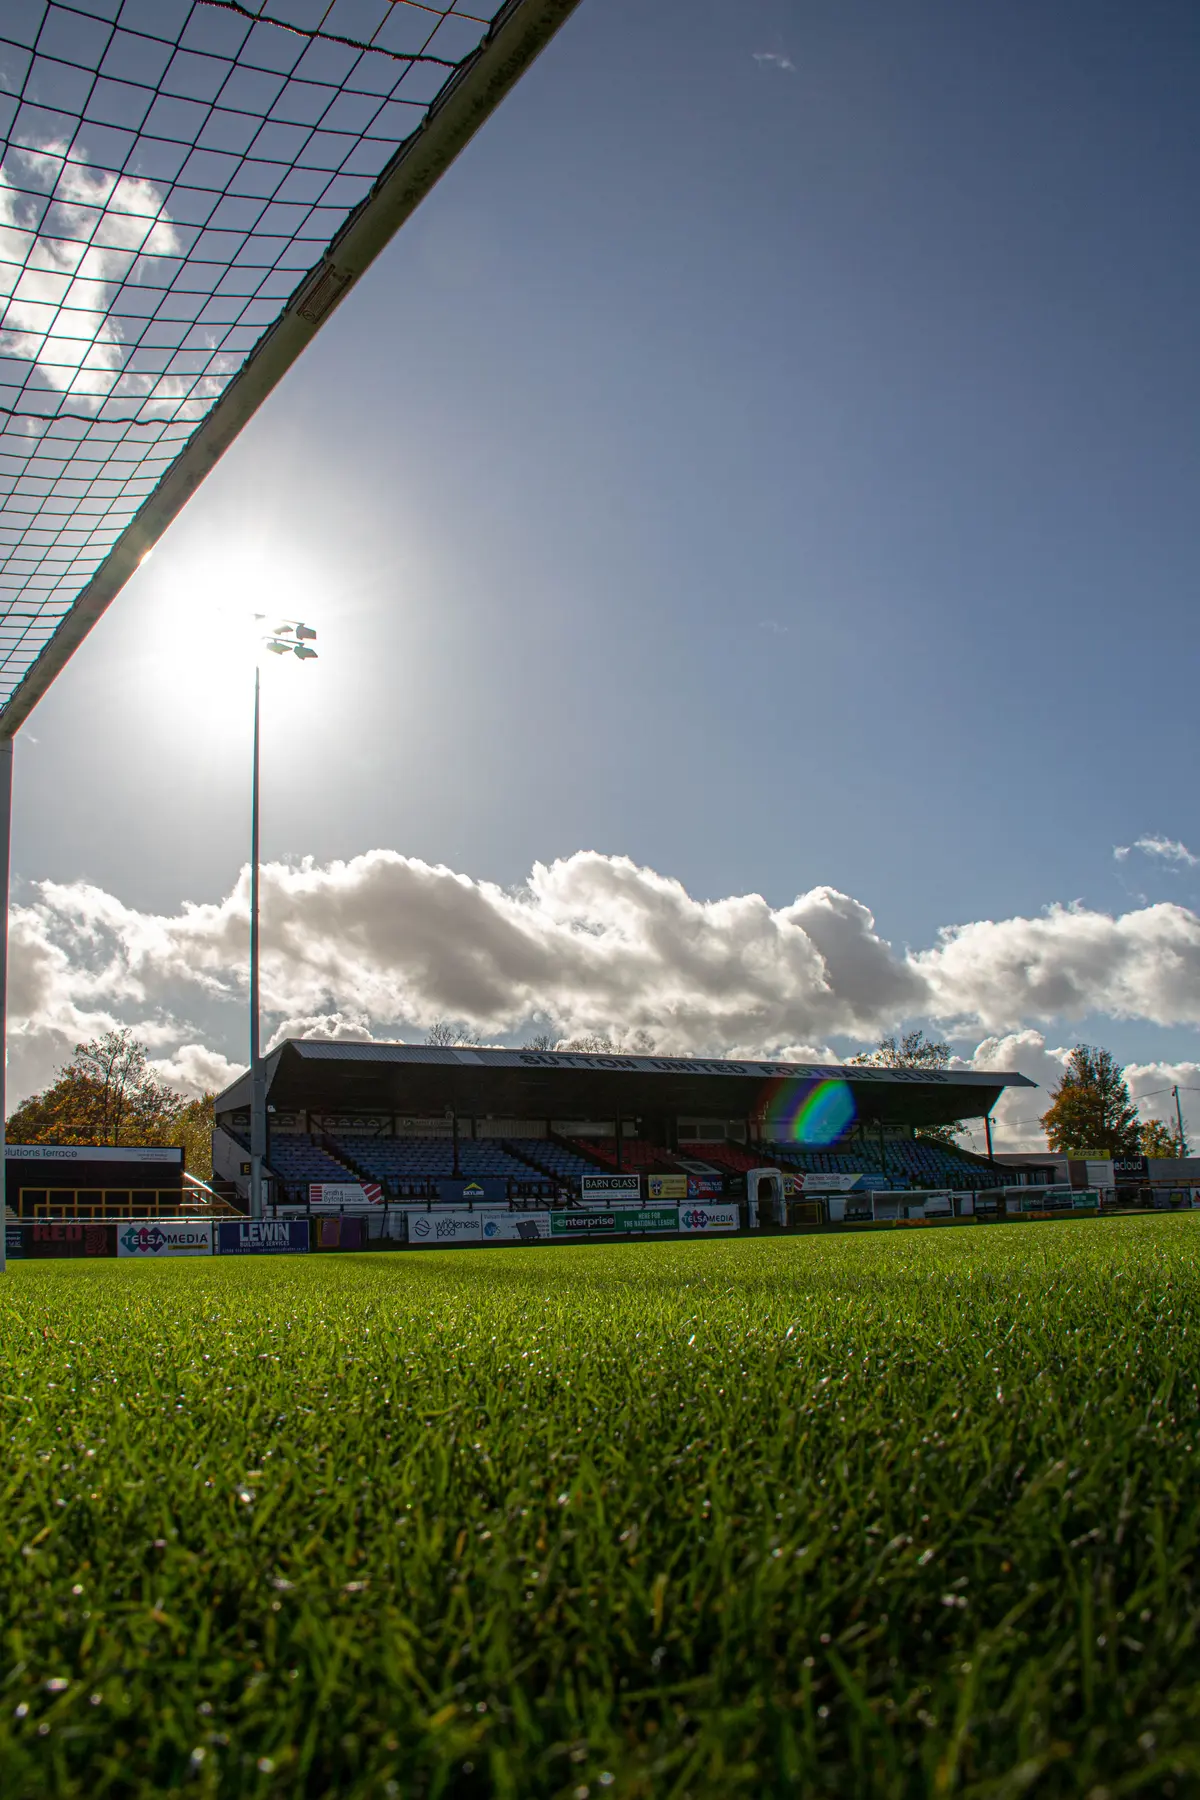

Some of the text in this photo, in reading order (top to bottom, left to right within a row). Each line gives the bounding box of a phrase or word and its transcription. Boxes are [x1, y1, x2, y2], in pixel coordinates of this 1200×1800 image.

[519, 1054, 949, 1082] SUTTON UNITED FOOTBALL CLUB
[42, 1148, 78, 1158] Terrace
[585, 1178, 636, 1188] BARN GLASS
[434, 1220, 480, 1229] wholeness
[554, 1216, 614, 1227] enterprise
[33, 1224, 82, 1240] RED
[240, 1223, 290, 1242] LEWIN
[436, 1228, 456, 1239] pod
[123, 1234, 208, 1245] TELSA MEDIA
